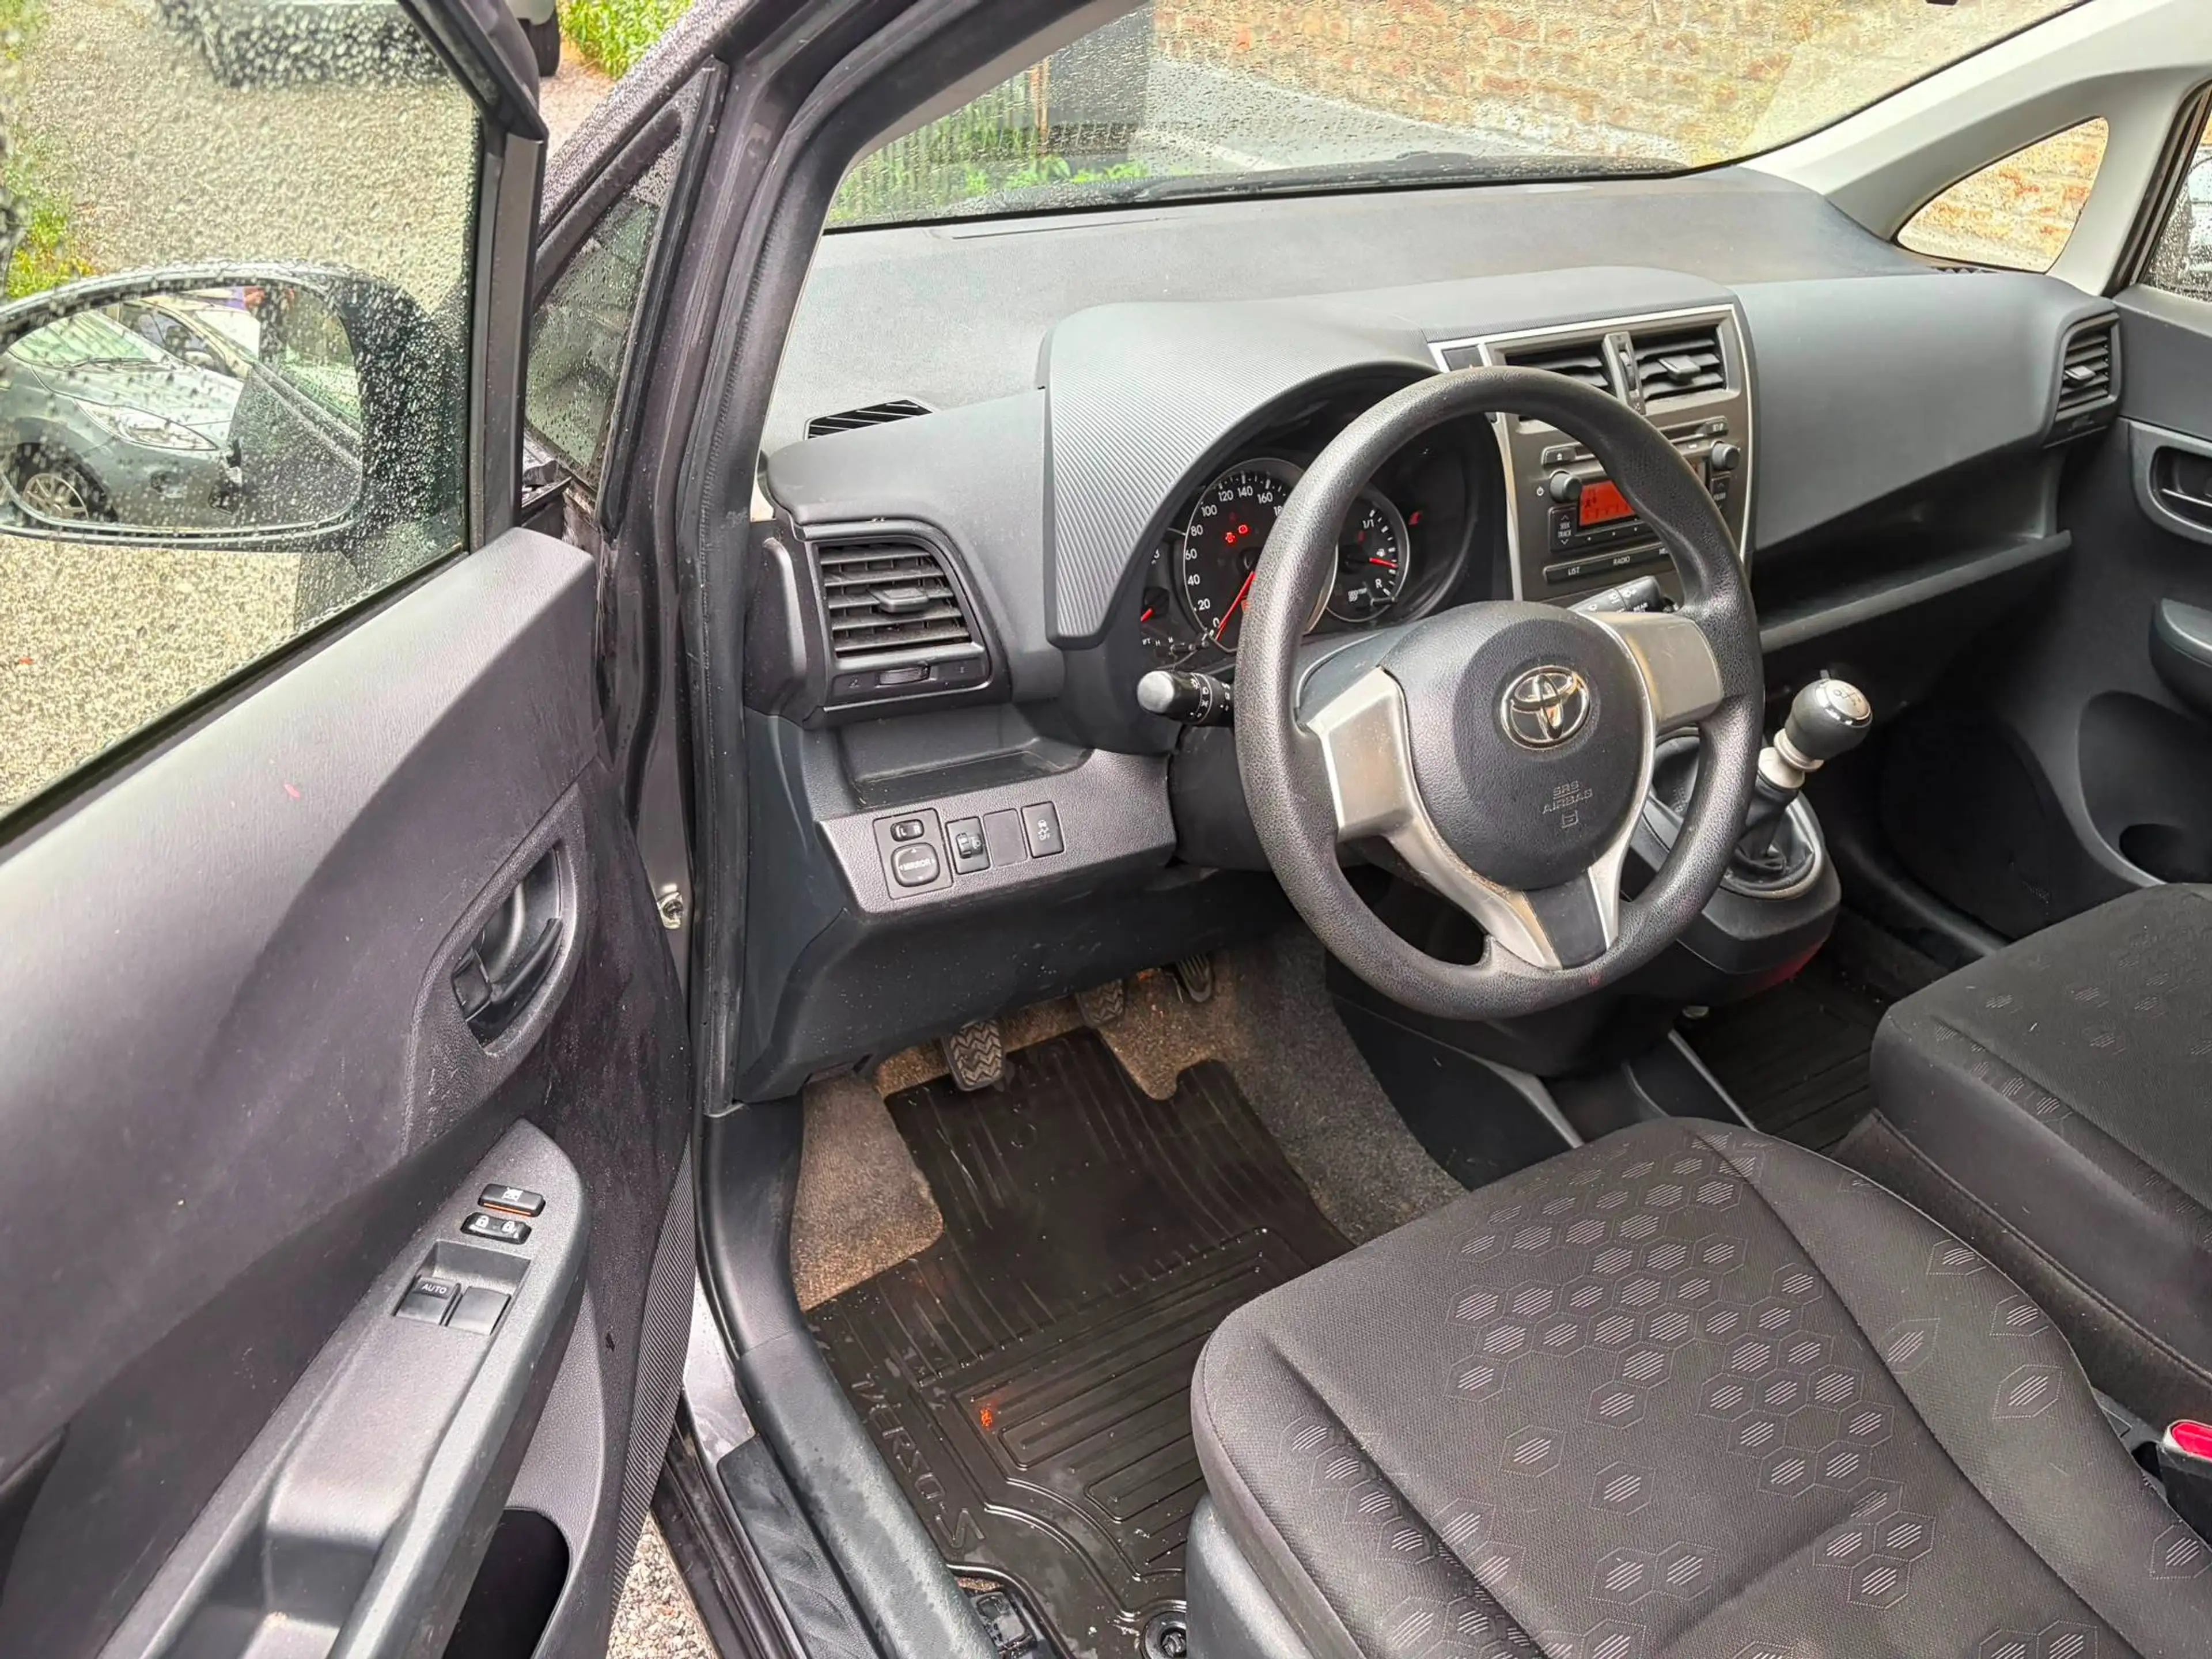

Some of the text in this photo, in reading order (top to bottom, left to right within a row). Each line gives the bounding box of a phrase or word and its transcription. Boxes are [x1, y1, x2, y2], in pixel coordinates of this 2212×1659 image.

[1218, 490, 1233, 502] 120
[1238, 486, 1253, 498] 140
[1257, 492, 1273, 504] 160
[1200, 505, 1217, 517] 100
[1274, 505, 1284, 516] 18
[1191, 525, 1203, 536] 80
[1185, 548, 1197, 560] 60
[1613, 555, 1631, 565] RADIO
[1567, 566, 1580, 576] LIST
[1188, 574, 1200, 586] 40
[1375, 578, 1382, 589] R
[1198, 599, 1210, 611] 20
[1553, 781, 1579, 797] SRS
[1542, 789, 1593, 815] AIRBAG
[421, 1283, 447, 1294] AUTO
